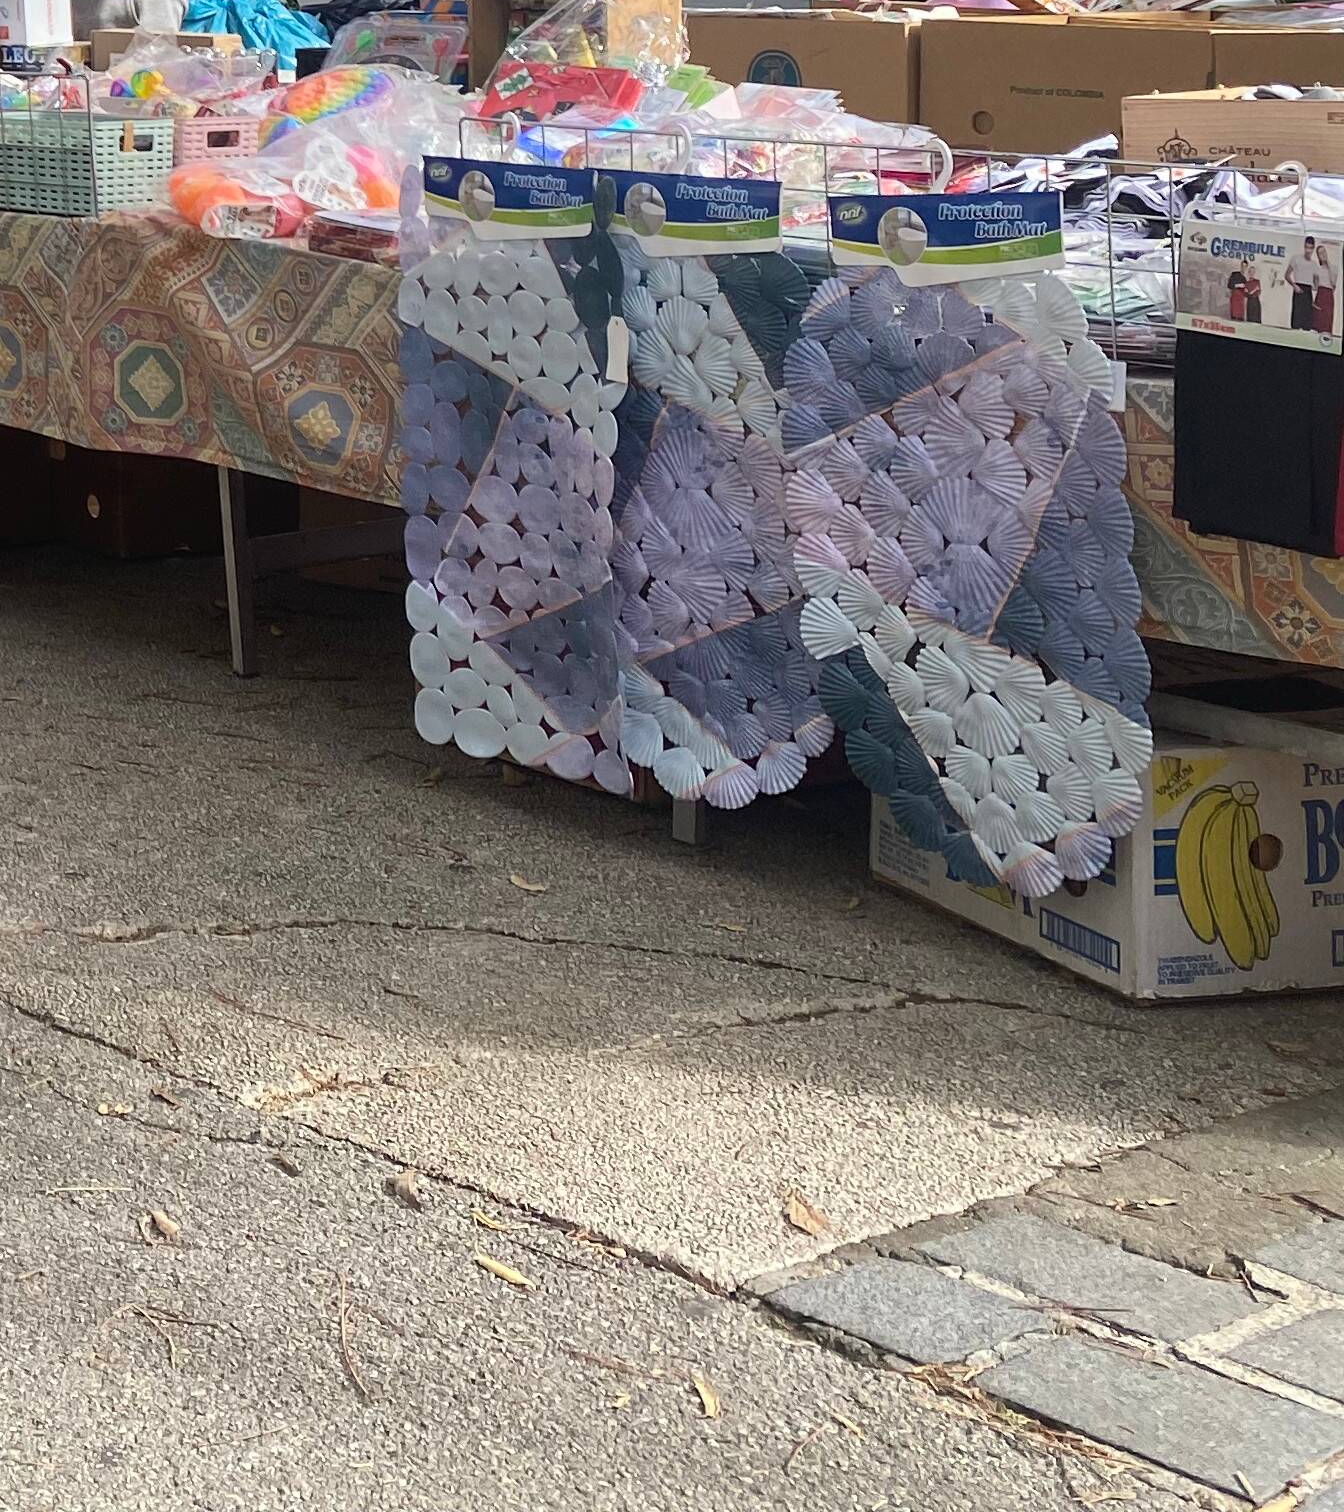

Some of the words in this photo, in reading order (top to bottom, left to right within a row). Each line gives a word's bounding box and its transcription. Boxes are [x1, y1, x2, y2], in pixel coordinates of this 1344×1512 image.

[1209, 144, 1271, 157] CHÂTEAU
[503, 170, 568, 191] Protection
[674, 182, 749, 204] Protection
[937, 201, 1024, 221] Protection
[1210, 236, 1286, 258] GREMBIULE
[1167, 778, 1194, 801] PACK
